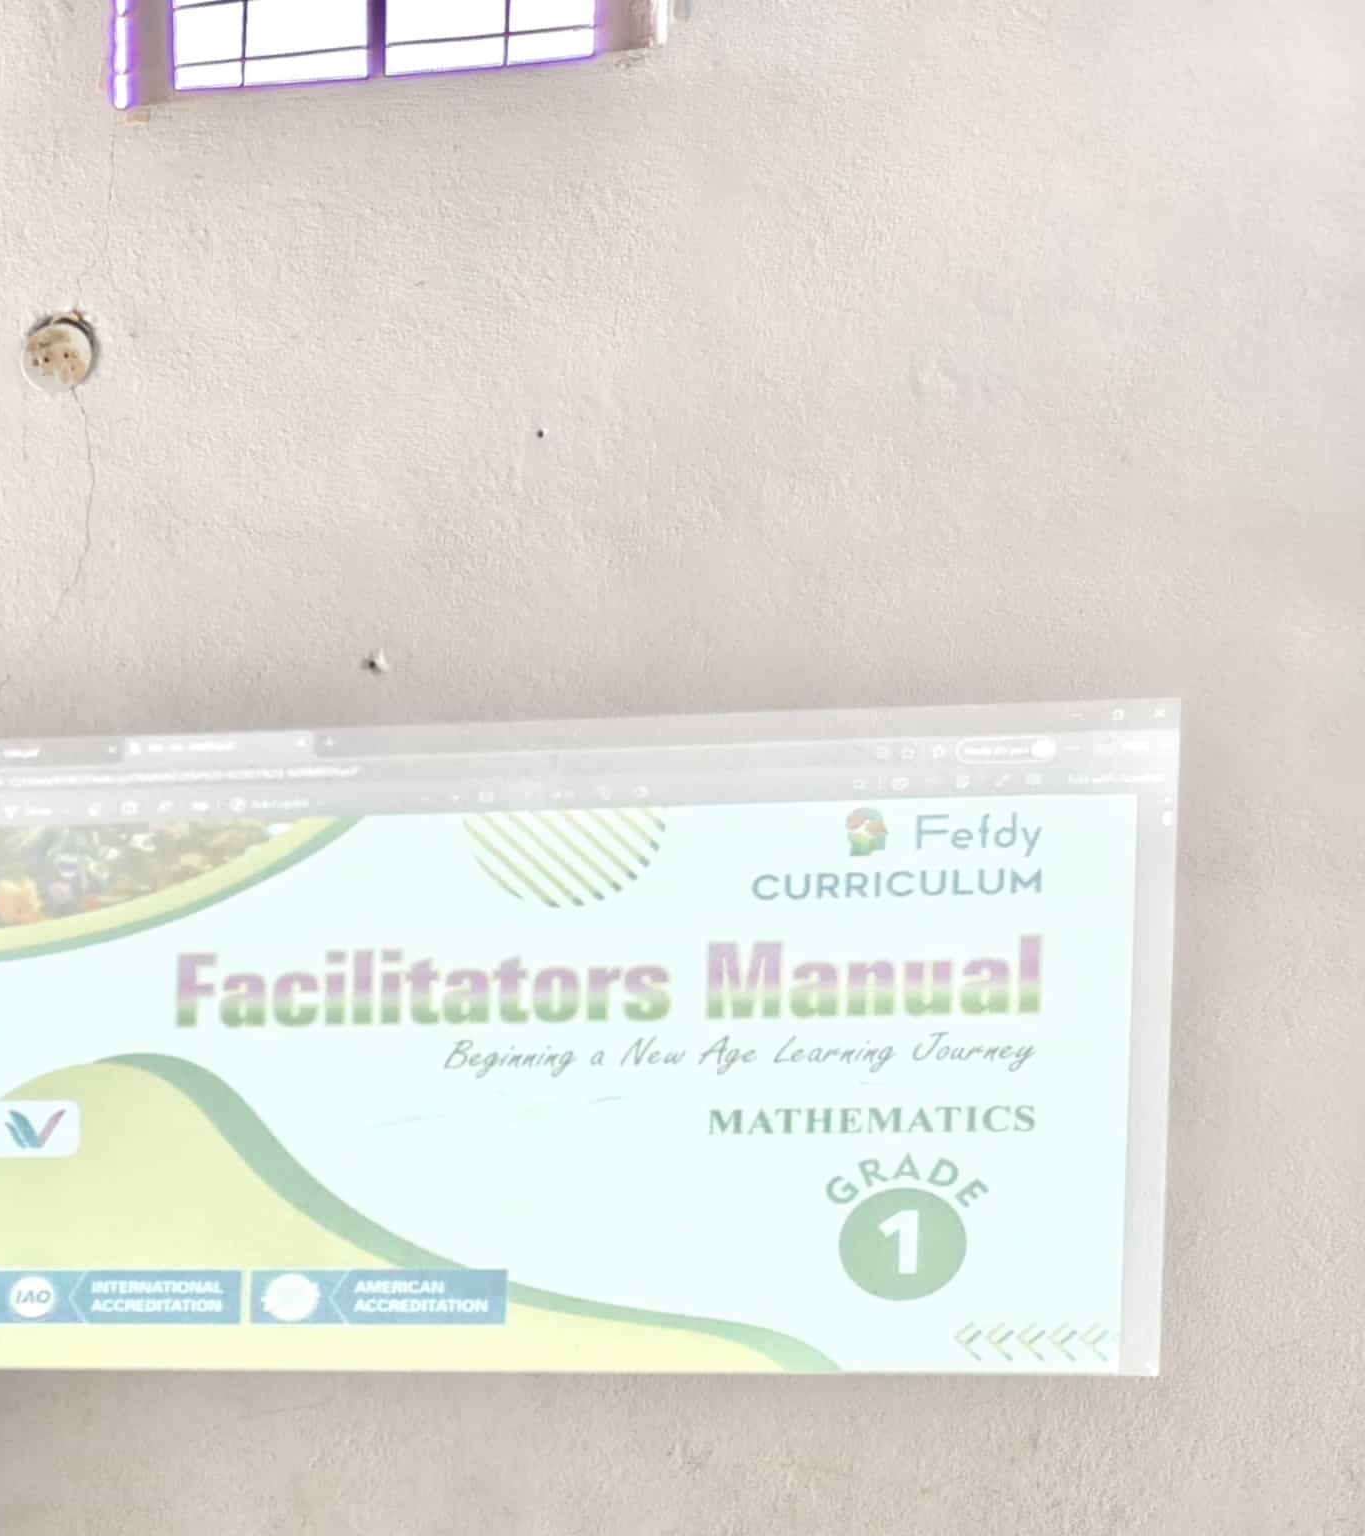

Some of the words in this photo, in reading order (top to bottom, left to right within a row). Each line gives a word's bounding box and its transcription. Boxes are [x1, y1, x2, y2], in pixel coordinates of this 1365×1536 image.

[915, 812, 1043, 858] Fefdy
[751, 867, 1043, 901] CURRICULUM
[174, 944, 672, 1029] Facilitators
[705, 933, 1045, 1020] Manual
[444, 1038, 576, 1079] Beginning
[590, 1049, 605, 1067] a
[620, 1037, 686, 1067] New
[697, 1035, 757, 1076] Age
[773, 1034, 897, 1073] Learning
[912, 1031, 1037, 1073] Journey
[707, 1104, 1036, 1137] MATHEMATICS
[826, 1153, 989, 1209] GRADE
[878, 1208, 920, 1275] 1
[15, 1289, 51, 1305] IAO
[90, 1280, 223, 1295] INTERNATIONAL
[354, 1280, 445, 1294] AMERICAN
[90, 1298, 223, 1313] ACCREDITATION
[354, 1298, 490, 1313] ACCREDITATION
